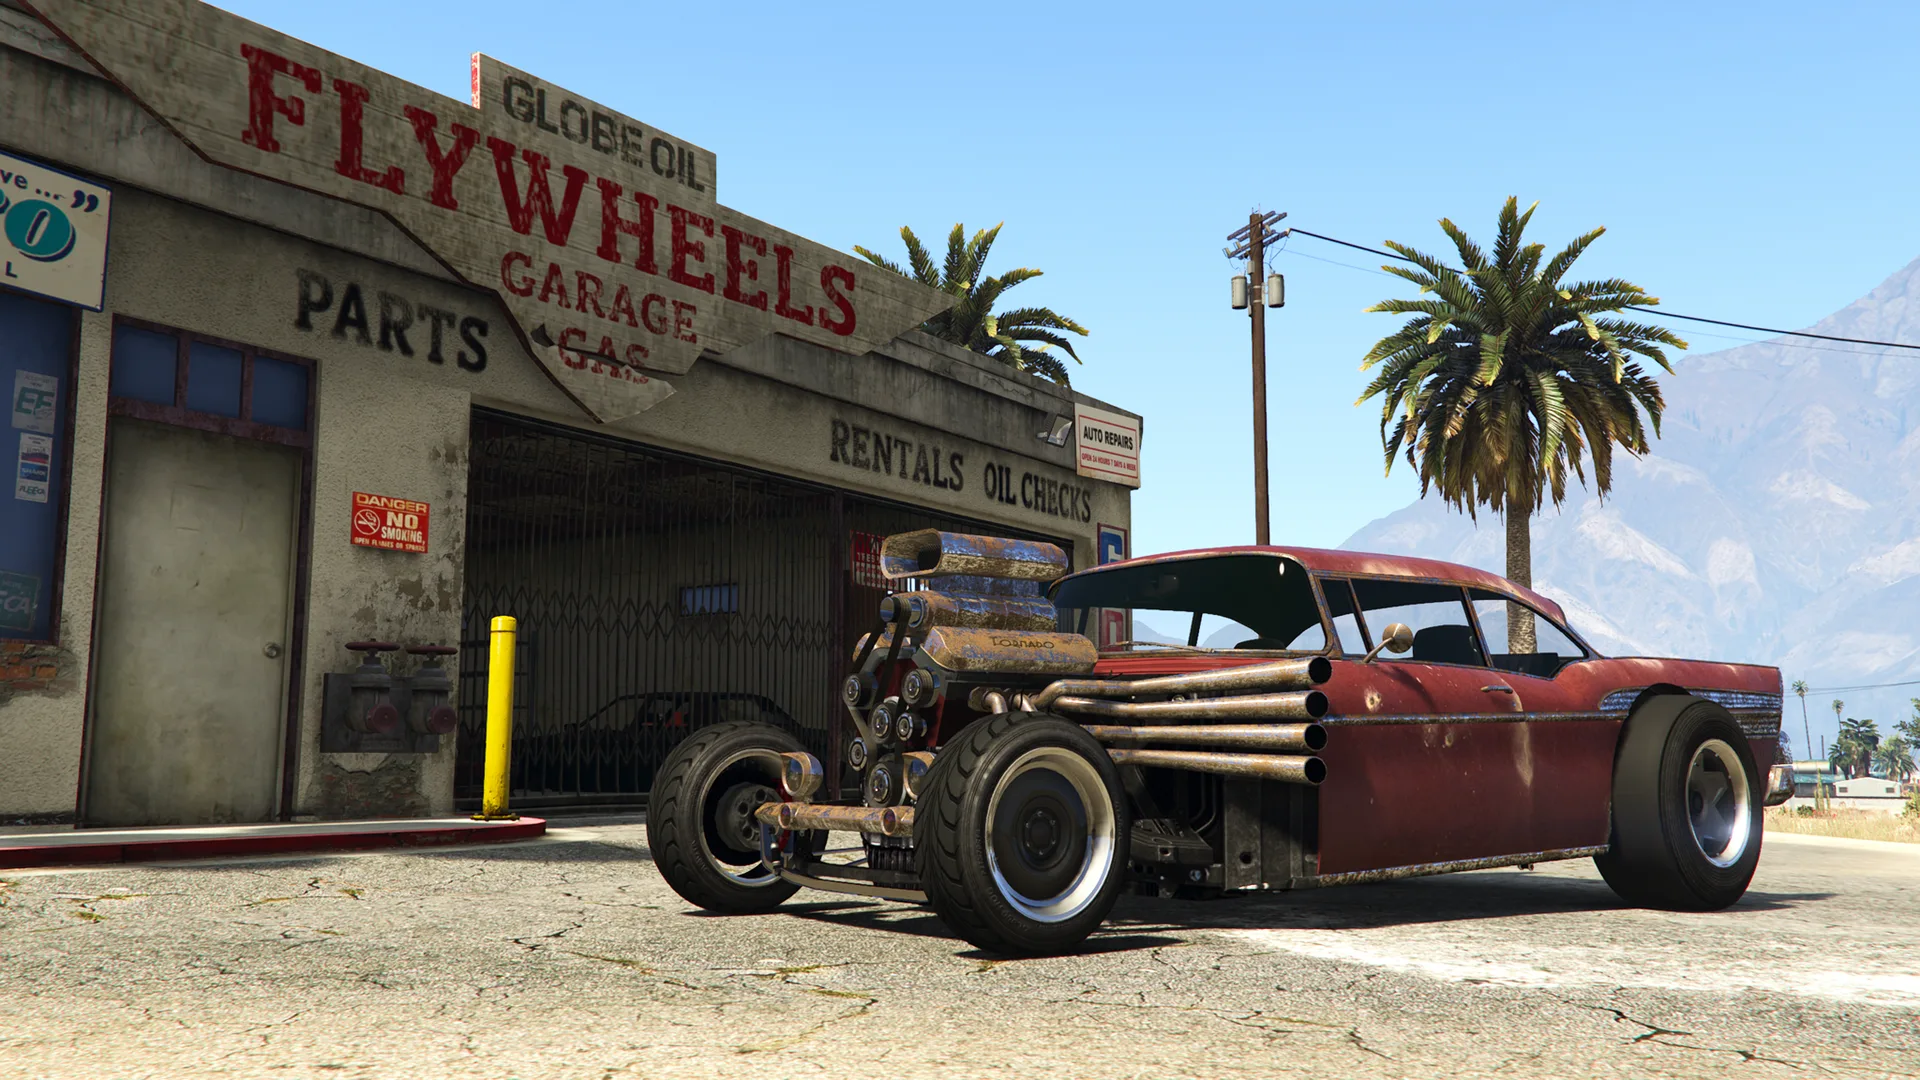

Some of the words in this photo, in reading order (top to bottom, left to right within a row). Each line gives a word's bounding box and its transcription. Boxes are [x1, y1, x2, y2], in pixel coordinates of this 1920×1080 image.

[503, 75, 644, 168] GLOBE
[650, 136, 705, 193] OIL
[241, 43, 857, 337] FLYWHEELS
[501, 250, 698, 344] GARAGE
[295, 267, 489, 373] PARTS
[557, 326, 650, 385] GAS
[829, 418, 964, 492] RENTALS
[1083, 425, 1103, 443] AUTO
[1104, 431, 1134, 451] REPAIRS
[1082, 453, 1092, 461] OPEN
[1098, 456, 1110, 465] HOURS
[1113, 460, 1122, 468] DAYS
[1127, 463, 1136, 471] WEEK
[356, 493, 428, 513] DANGER
[983, 461, 1017, 505] OIL
[1021, 471, 1092, 524] CHECKS
[381, 526, 426, 546] SMOKING,
[386, 511, 419, 530] NO
[354, 536, 370, 545] OPEN
[371, 539, 394, 548] FLAMES
[405, 543, 426, 552] SPARKS
[989, 635, 1055, 649] TORNADO
